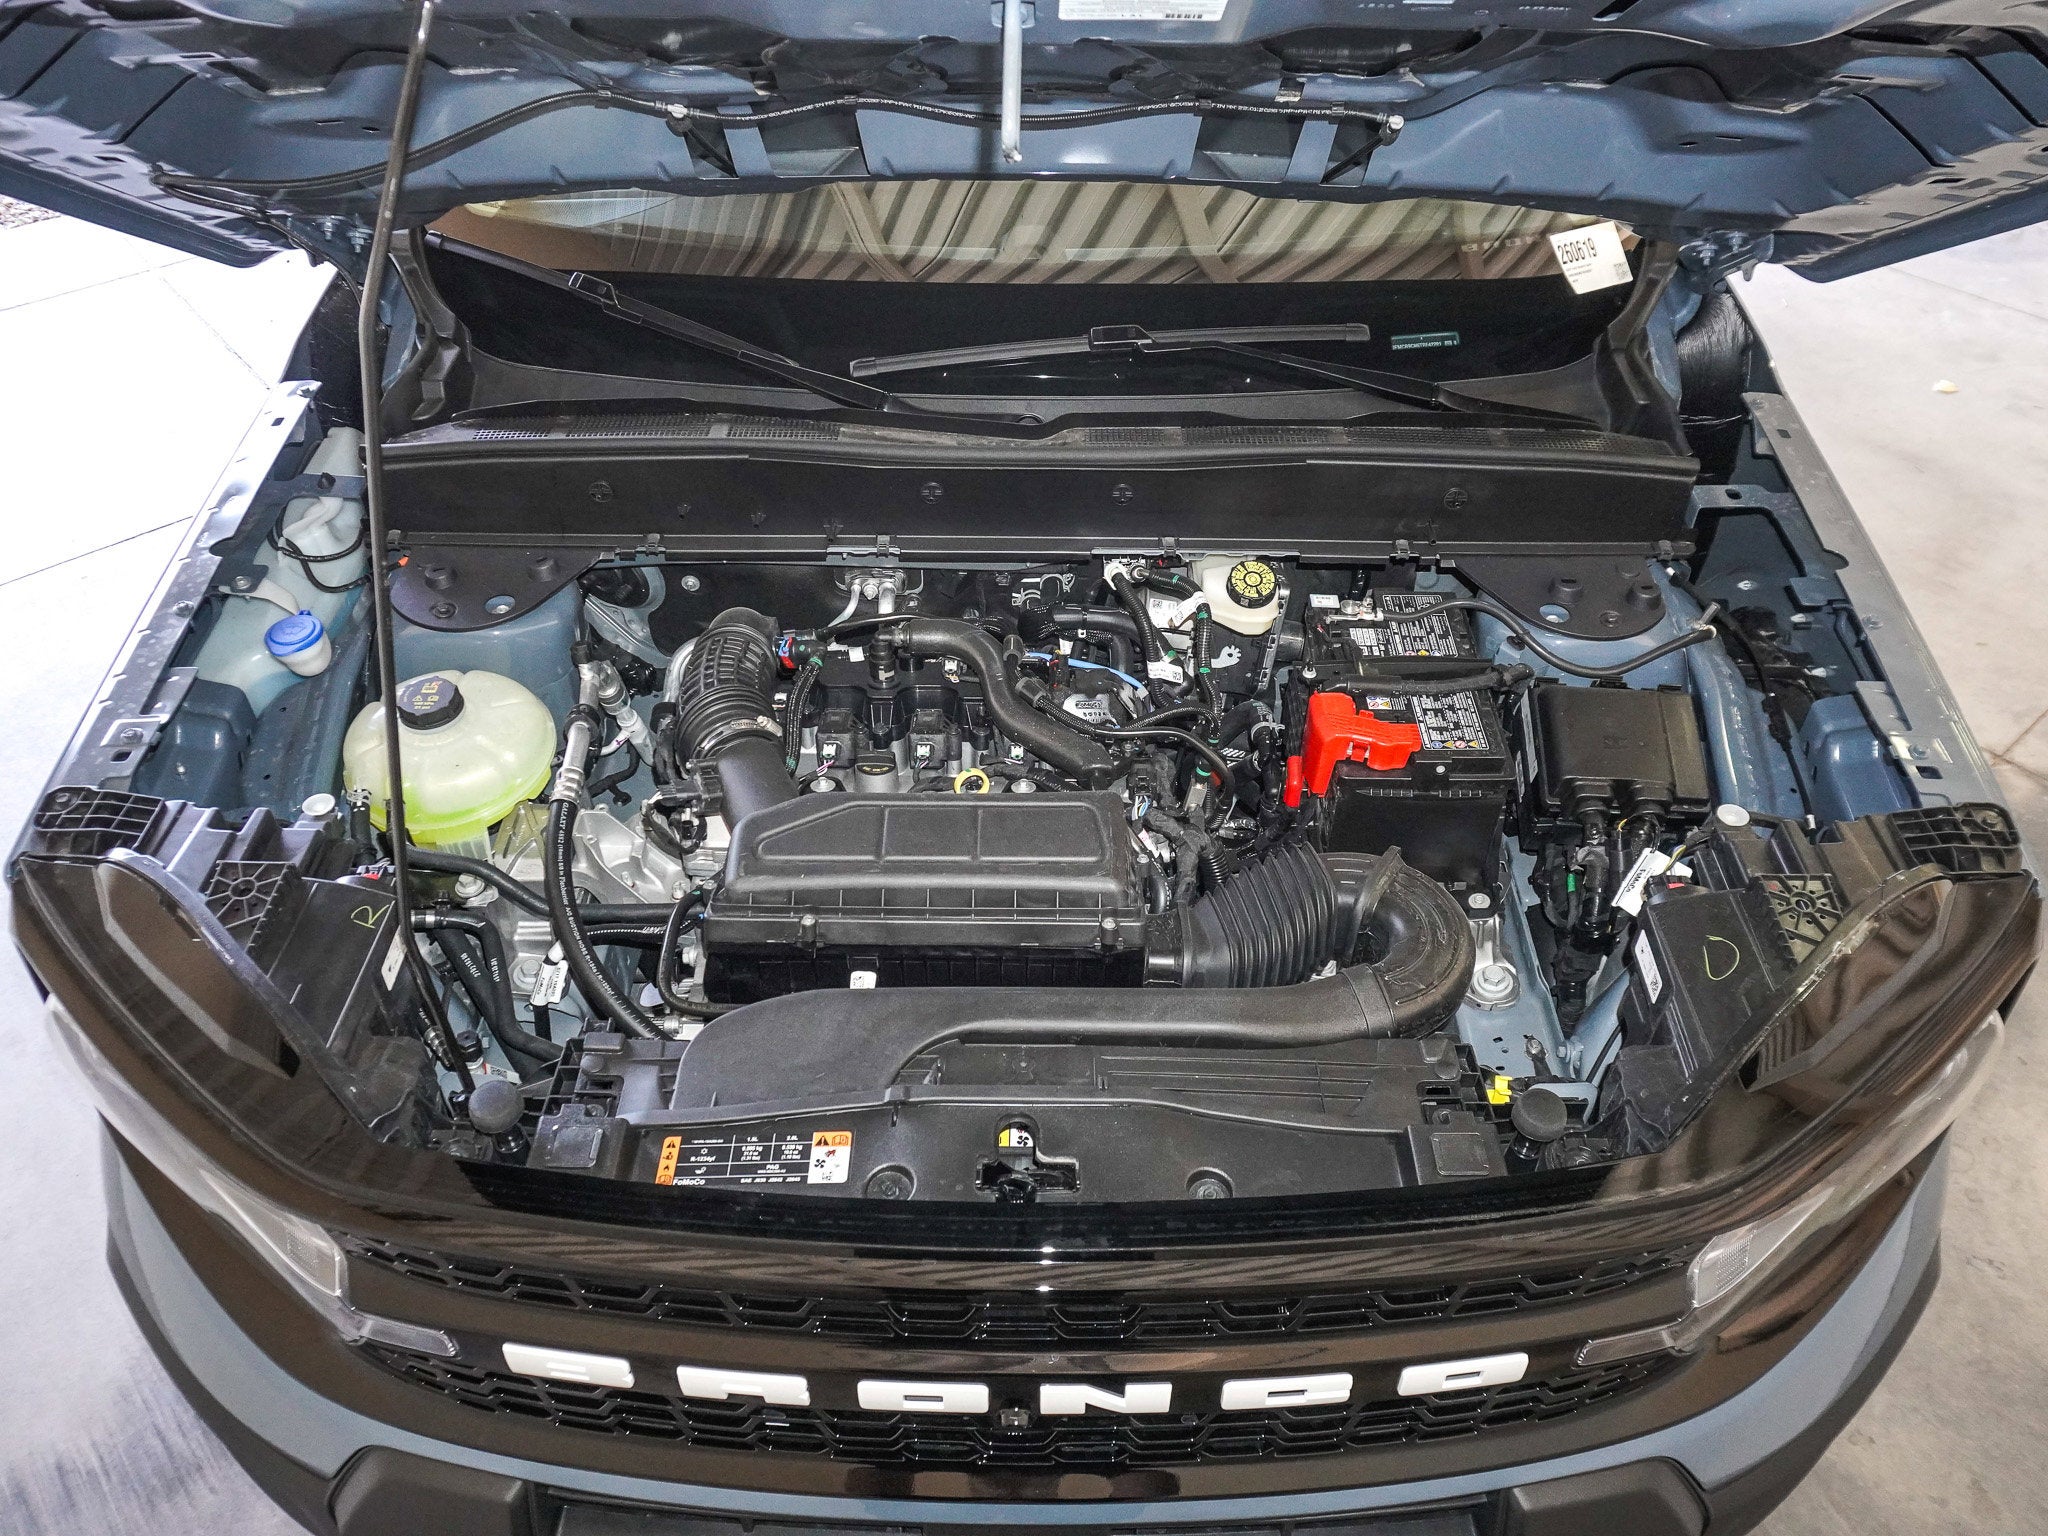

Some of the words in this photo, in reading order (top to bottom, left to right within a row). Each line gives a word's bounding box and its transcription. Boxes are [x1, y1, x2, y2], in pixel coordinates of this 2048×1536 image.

[1557, 237, 1598, 265] 260619
[568, 916, 582, 941] SUCTION
[672, 1178, 706, 1186] FoMoCo
[502, 1342, 1529, 1415] BRONCO
